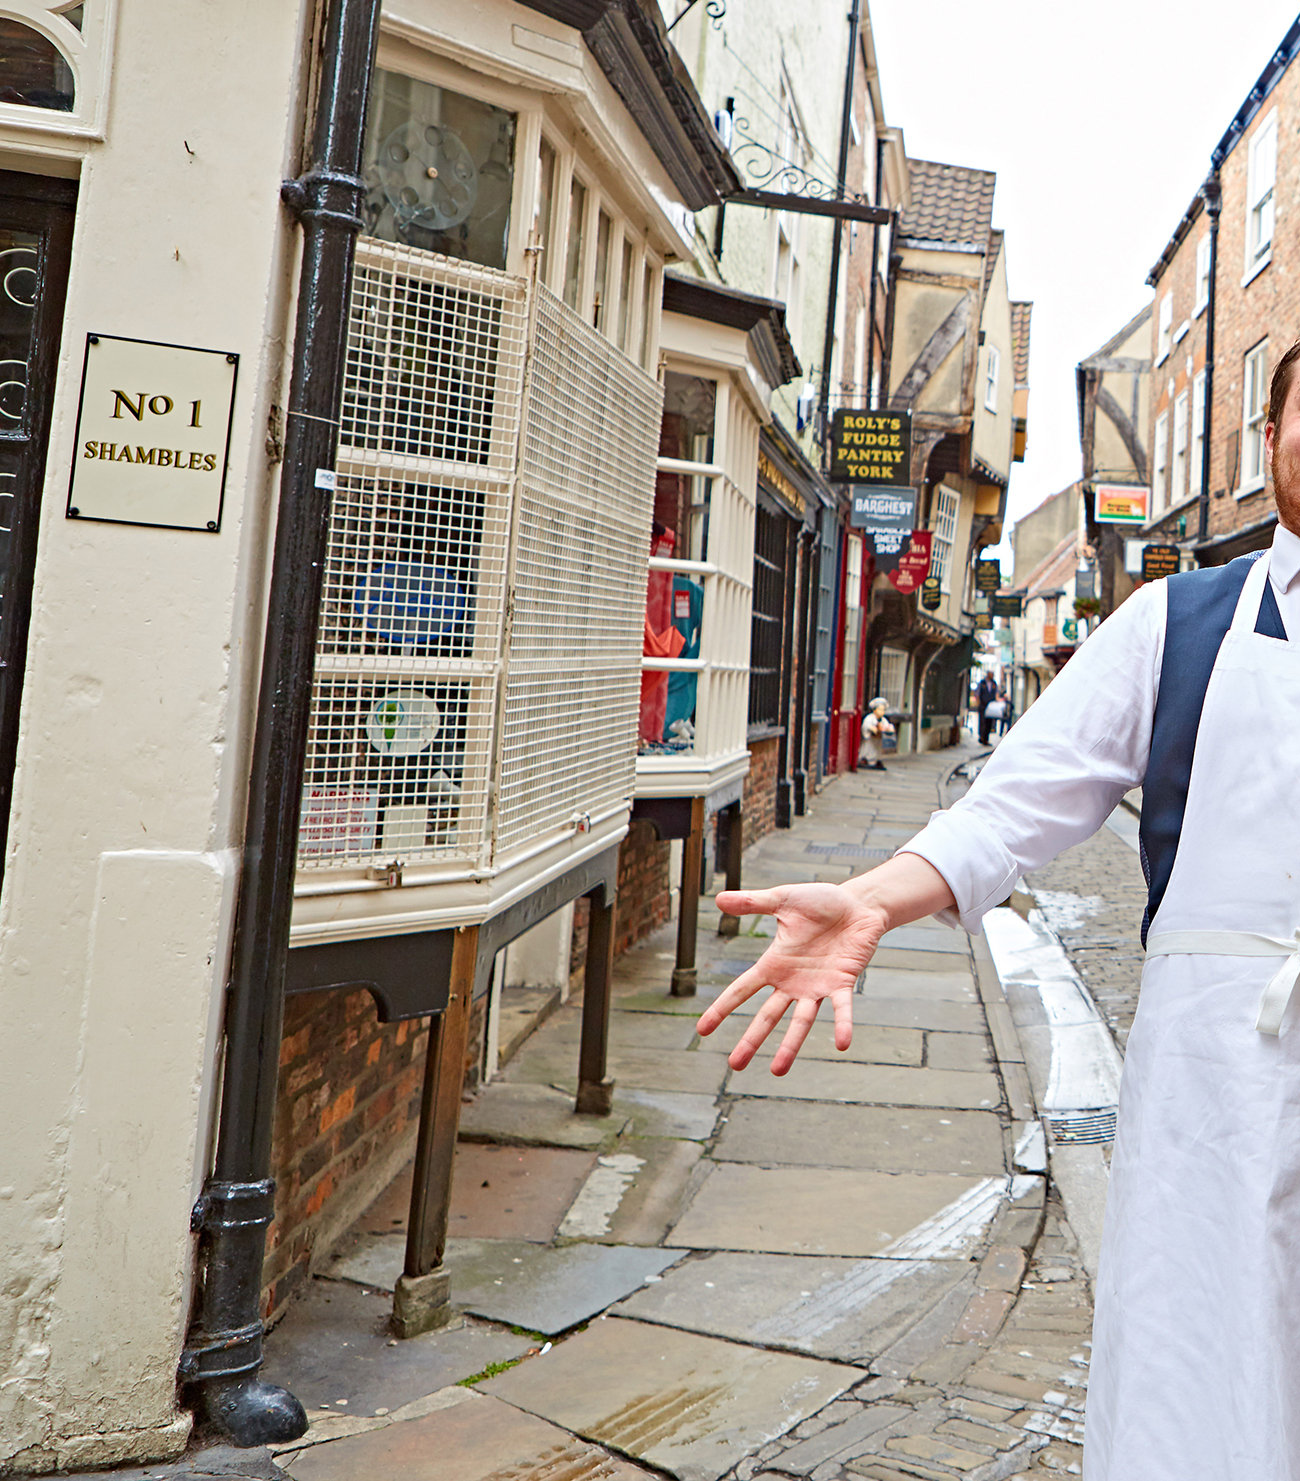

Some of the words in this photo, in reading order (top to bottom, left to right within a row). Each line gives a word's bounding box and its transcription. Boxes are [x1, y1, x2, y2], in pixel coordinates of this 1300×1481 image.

[186, 400, 204, 428] 1
[843, 416, 901, 431] ROLY'S
[842, 432, 901, 447] FUDGE
[83, 440, 217, 472] SHAMBLES
[837, 448, 904, 463] PANTRY
[847, 465, 894, 479] YORK
[855, 498, 914, 516] BARGHEST
[876, 543, 901, 554] SHOP
